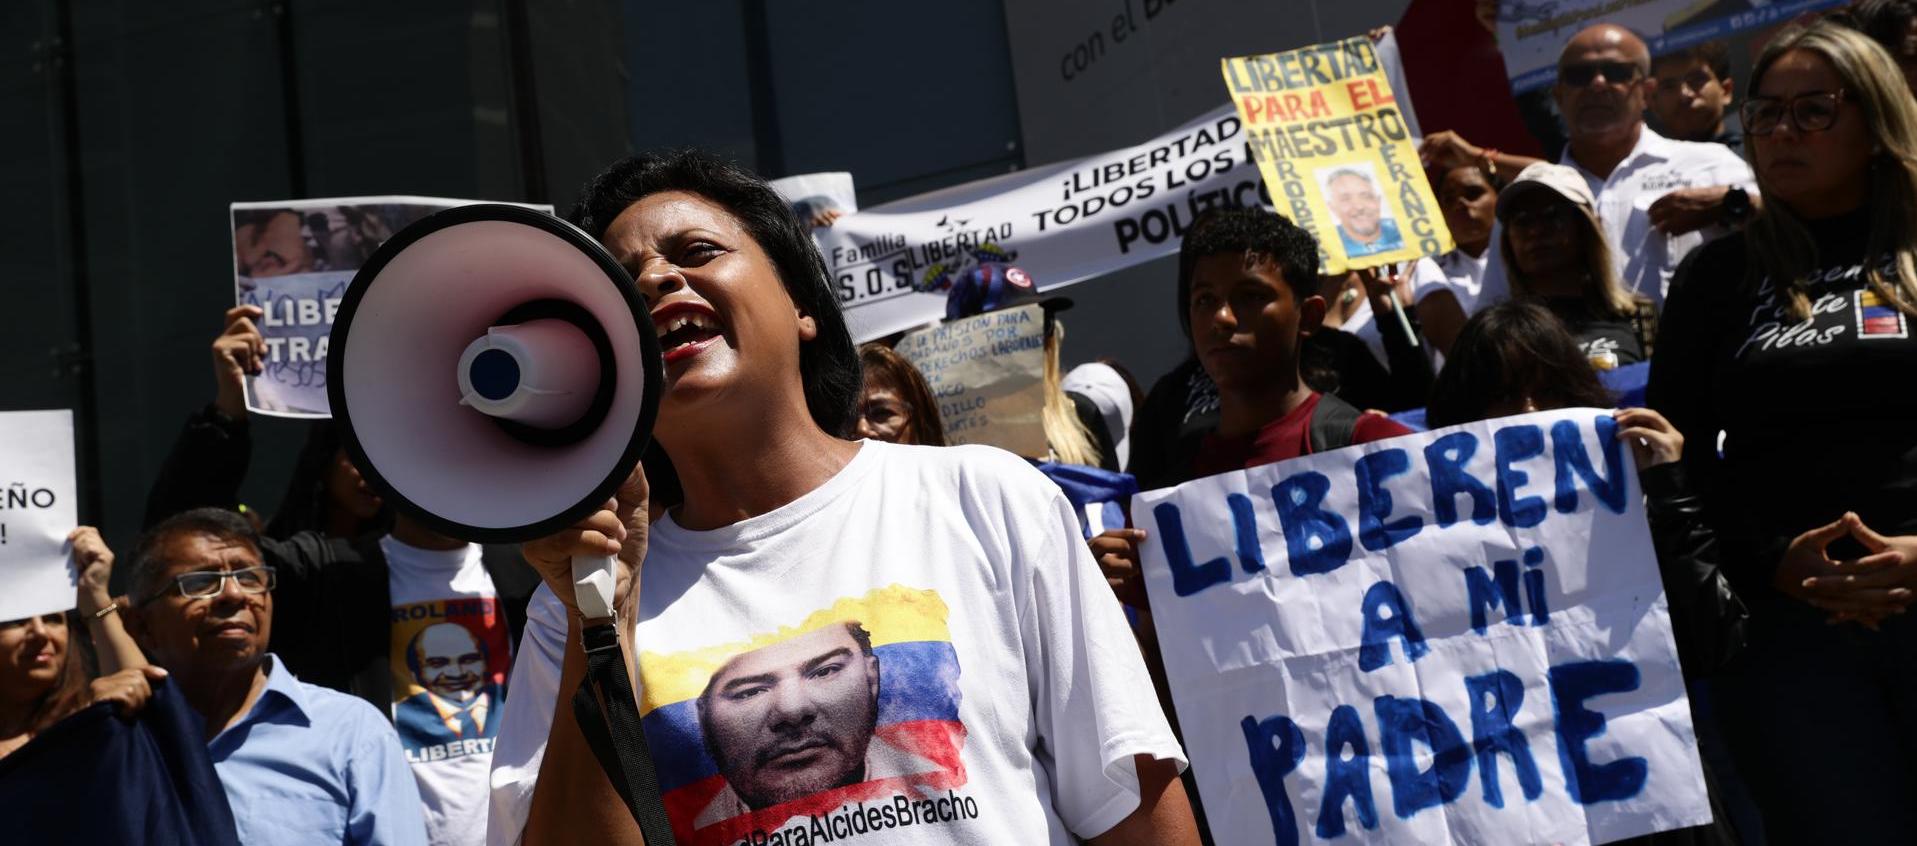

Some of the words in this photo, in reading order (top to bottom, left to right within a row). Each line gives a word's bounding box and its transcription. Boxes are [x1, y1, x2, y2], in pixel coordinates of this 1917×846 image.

[1061, 31, 1105, 82] con
[1111, 0, 1137, 43] el
[1226, 37, 1379, 94] LIBERTAD
[1241, 90, 1333, 125] PARA
[1345, 78, 1395, 112] EL
[1247, 108, 1407, 162] MAESTRO
[1033, 176, 1155, 232] TODOS
[1166, 149, 1234, 190] LOS
[1063, 116, 1242, 201] ¡LIBERTAD
[1380, 143, 1441, 257] FRANCO
[832, 231, 906, 268] Familia
[910, 221, 1013, 270] LIBERTAD
[1735, 317, 1846, 359] Pilas
[1153, 414, 1627, 598] LIBEREN
[1359, 580, 1431, 673] A
[1240, 659, 1649, 846] PADRE
